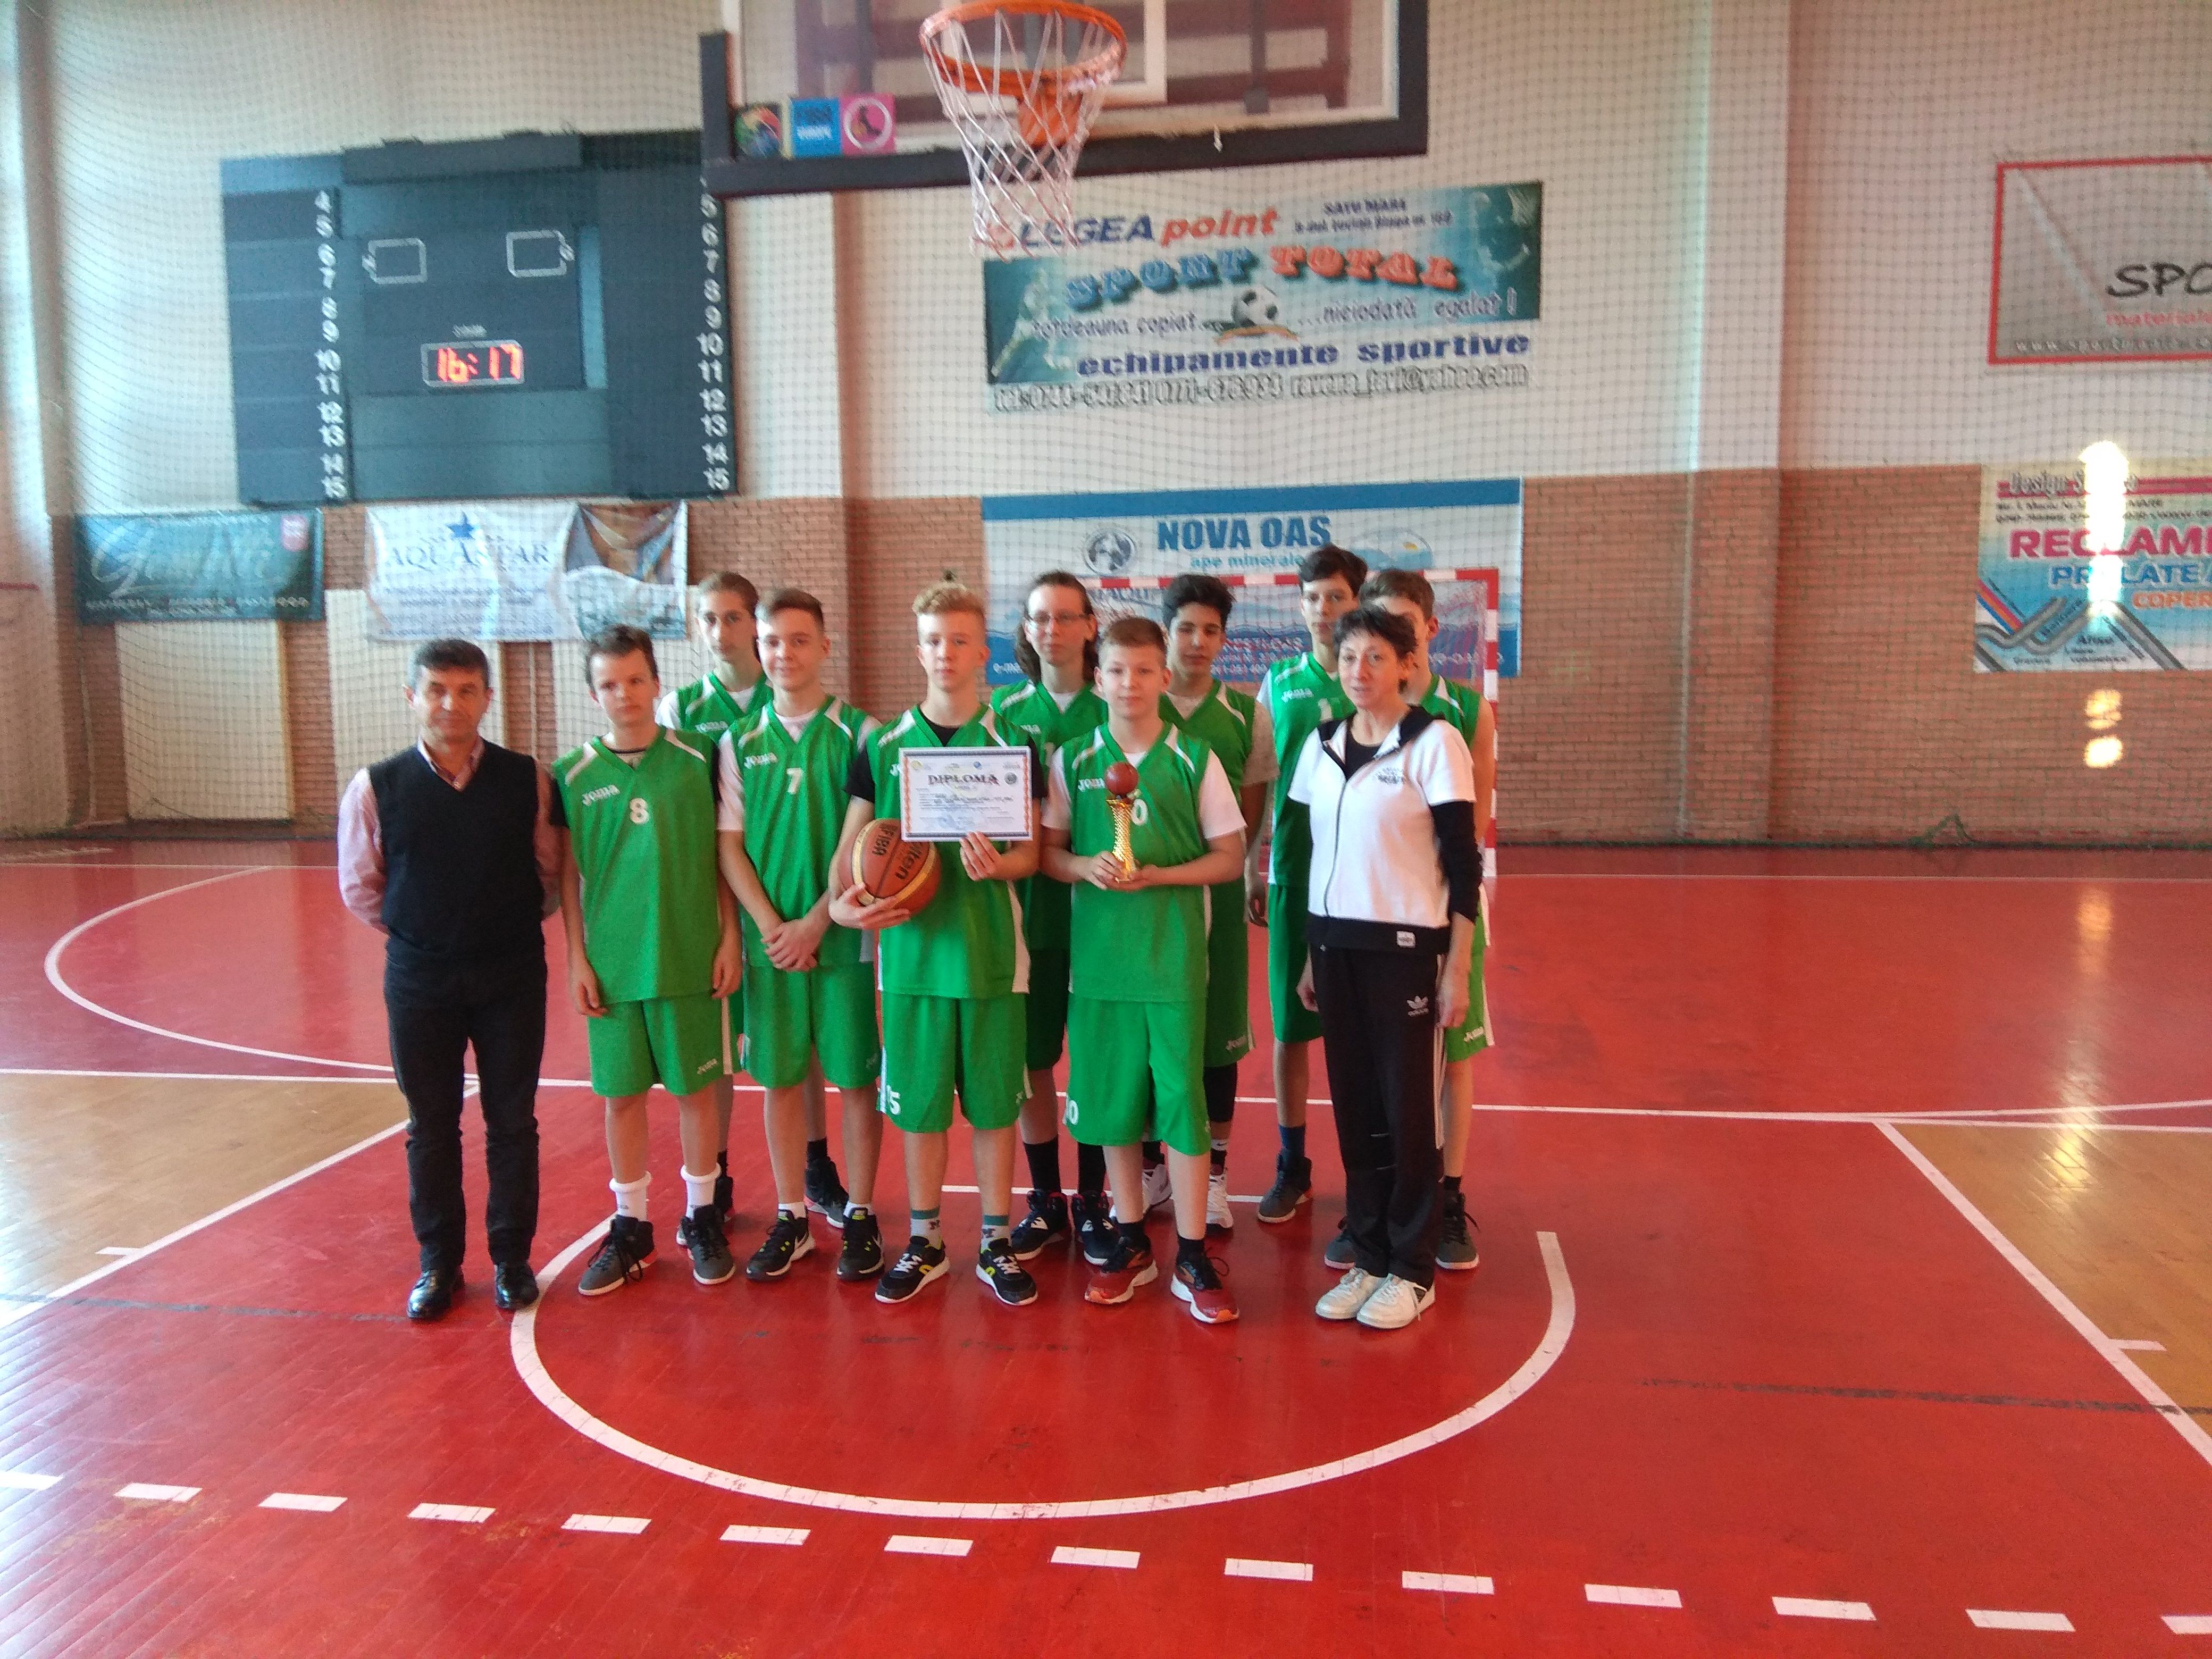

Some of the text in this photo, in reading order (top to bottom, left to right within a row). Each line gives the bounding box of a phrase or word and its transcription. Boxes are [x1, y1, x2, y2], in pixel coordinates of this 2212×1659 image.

[1160, 208, 1280, 248] point
[1065, 245, 1459, 308] SPORT TOTAL
[437, 343, 523, 383] 16:17
[1077, 333, 1530, 377] echipamente sportive
[1157, 515, 1331, 551] NOVA OAS
[2009, 525, 2212, 559] RECAM
[2051, 563, 2199, 586] PRLATE
[786, 767, 803, 795] 7
[927, 773, 1001, 787] DIPLOMA
[629, 797, 650, 825] 8
[1130, 798, 1148, 826] 0
